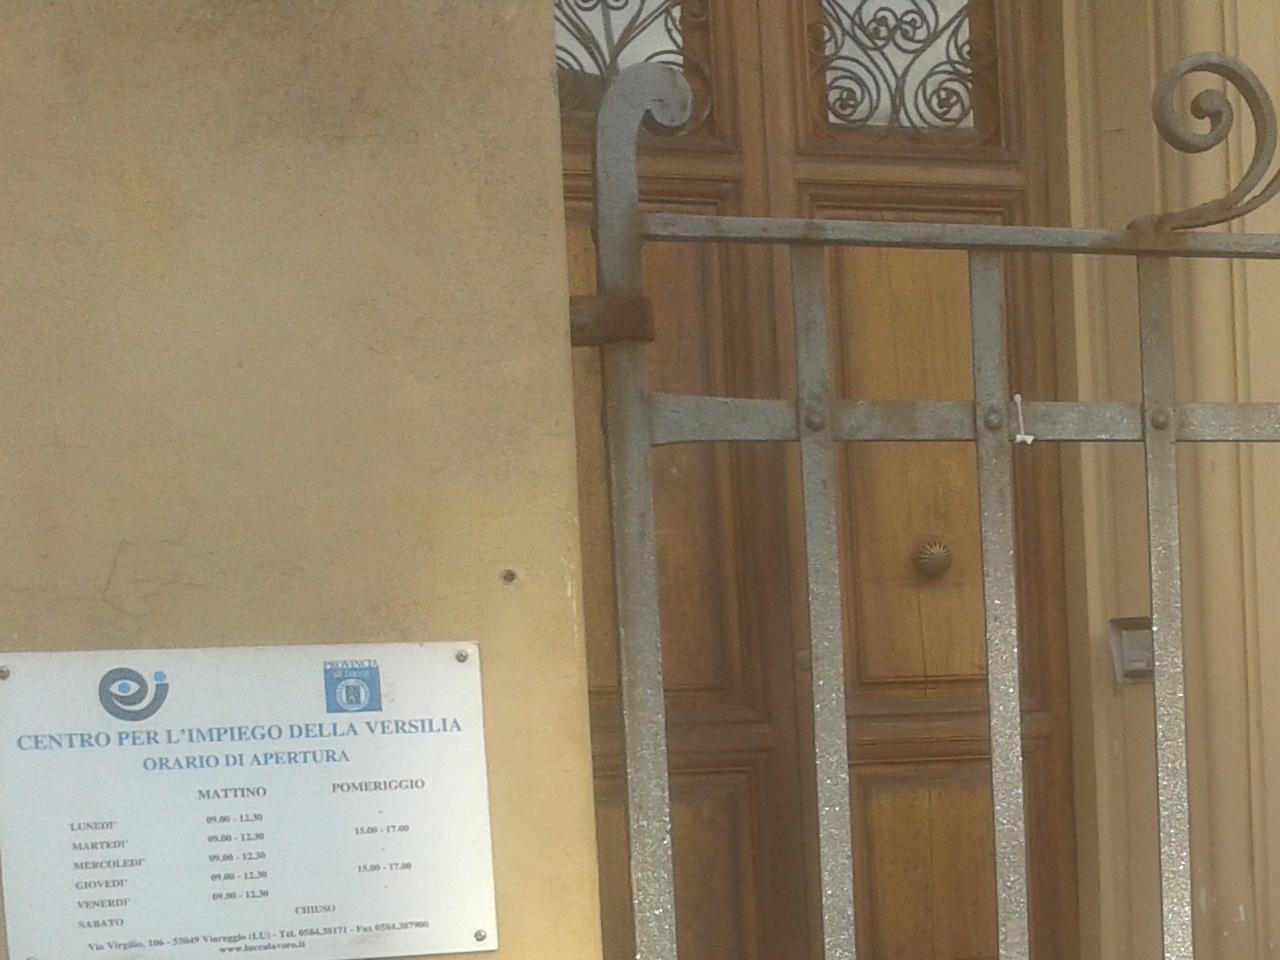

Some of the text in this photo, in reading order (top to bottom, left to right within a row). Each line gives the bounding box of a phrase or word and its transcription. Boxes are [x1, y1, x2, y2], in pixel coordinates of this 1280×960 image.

[17, 718, 463, 751] CENTRO PER L'IMPIEGO DELLA VERSILIA
[143, 749, 350, 771] ORARIO DI APERTURA
[198, 786, 268, 801] MATTINO
[332, 778, 425, 794] POMERIGGIO
[295, 904, 336, 915] CHIUSO
[78, 918, 124, 930] SABATO
[88, 942, 104, 951] Via
